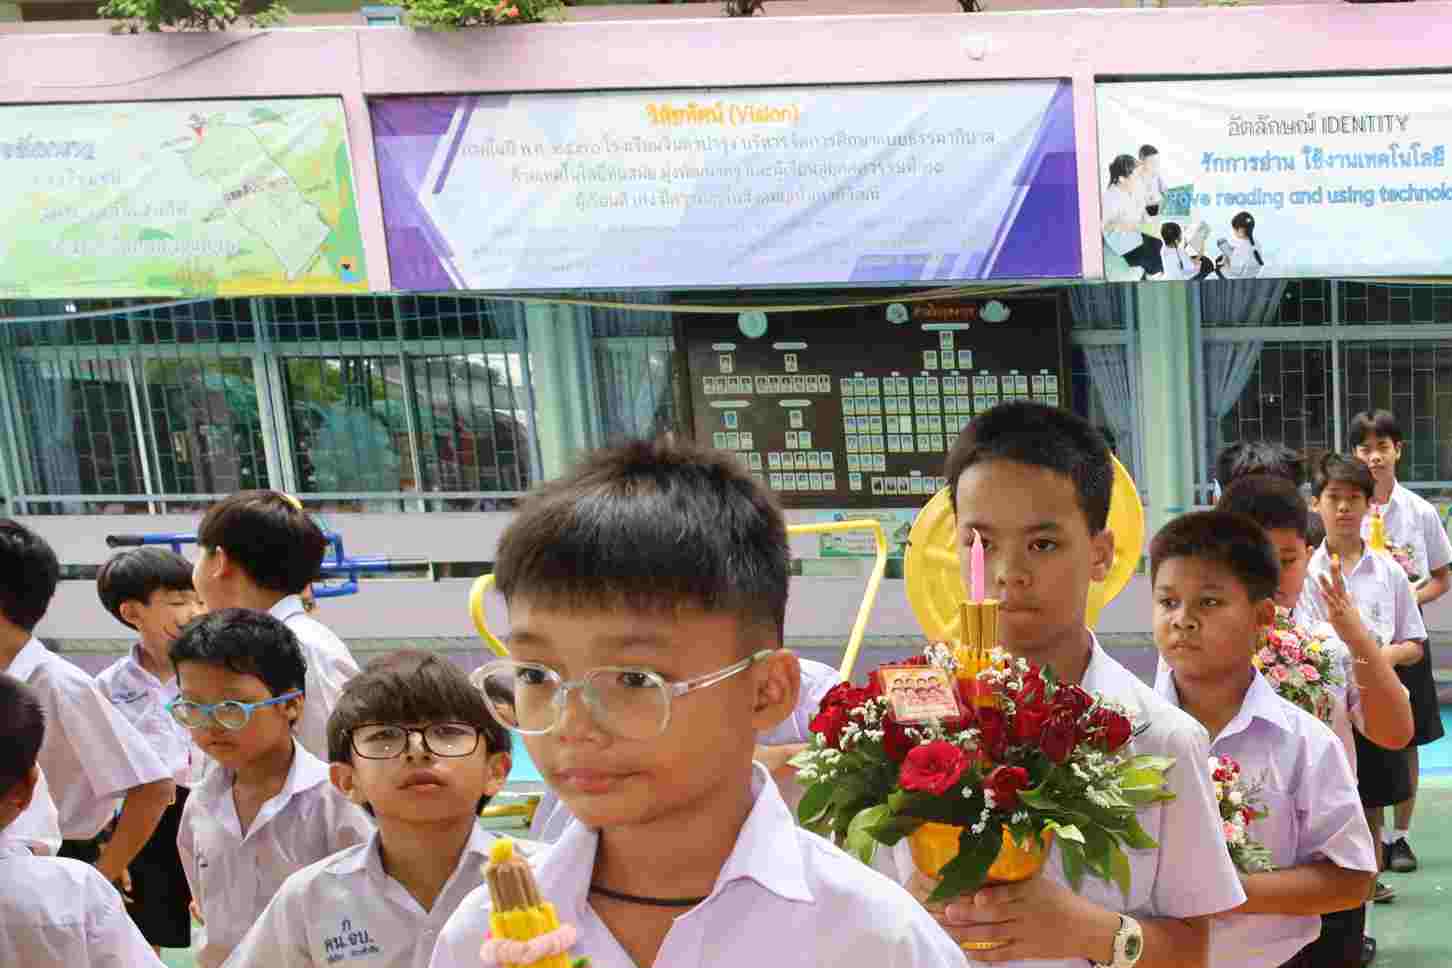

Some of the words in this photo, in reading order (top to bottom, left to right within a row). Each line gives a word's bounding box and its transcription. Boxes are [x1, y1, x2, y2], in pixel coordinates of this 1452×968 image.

[1321, 112, 1410, 135] IDENTITY
[1215, 186, 1284, 210] reading
[1289, 185, 1324, 205] and
[1327, 184, 1376, 208] using
